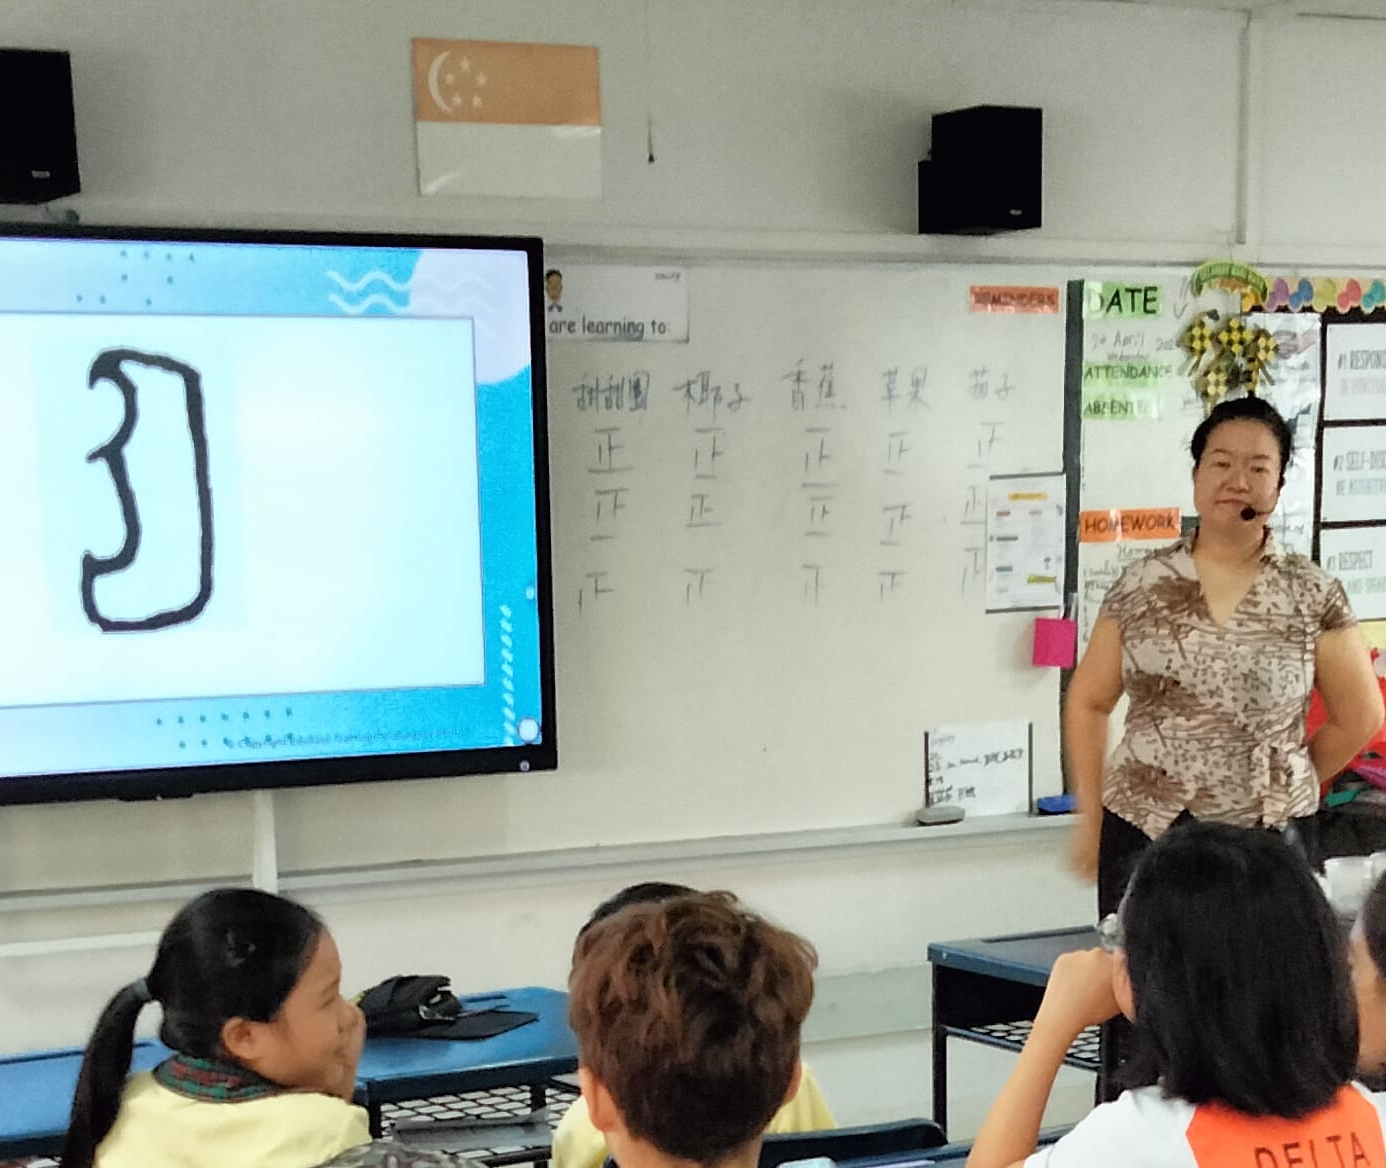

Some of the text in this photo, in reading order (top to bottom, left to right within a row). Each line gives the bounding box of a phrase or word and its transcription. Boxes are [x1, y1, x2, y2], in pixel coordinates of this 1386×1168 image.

[1087, 284, 1158, 315] DATE
[549, 321, 575, 335] are
[582, 314, 644, 340] learning
[1084, 515, 1176, 534] HOMEWORK
[1338, 549, 1373, 571] RESPECT
